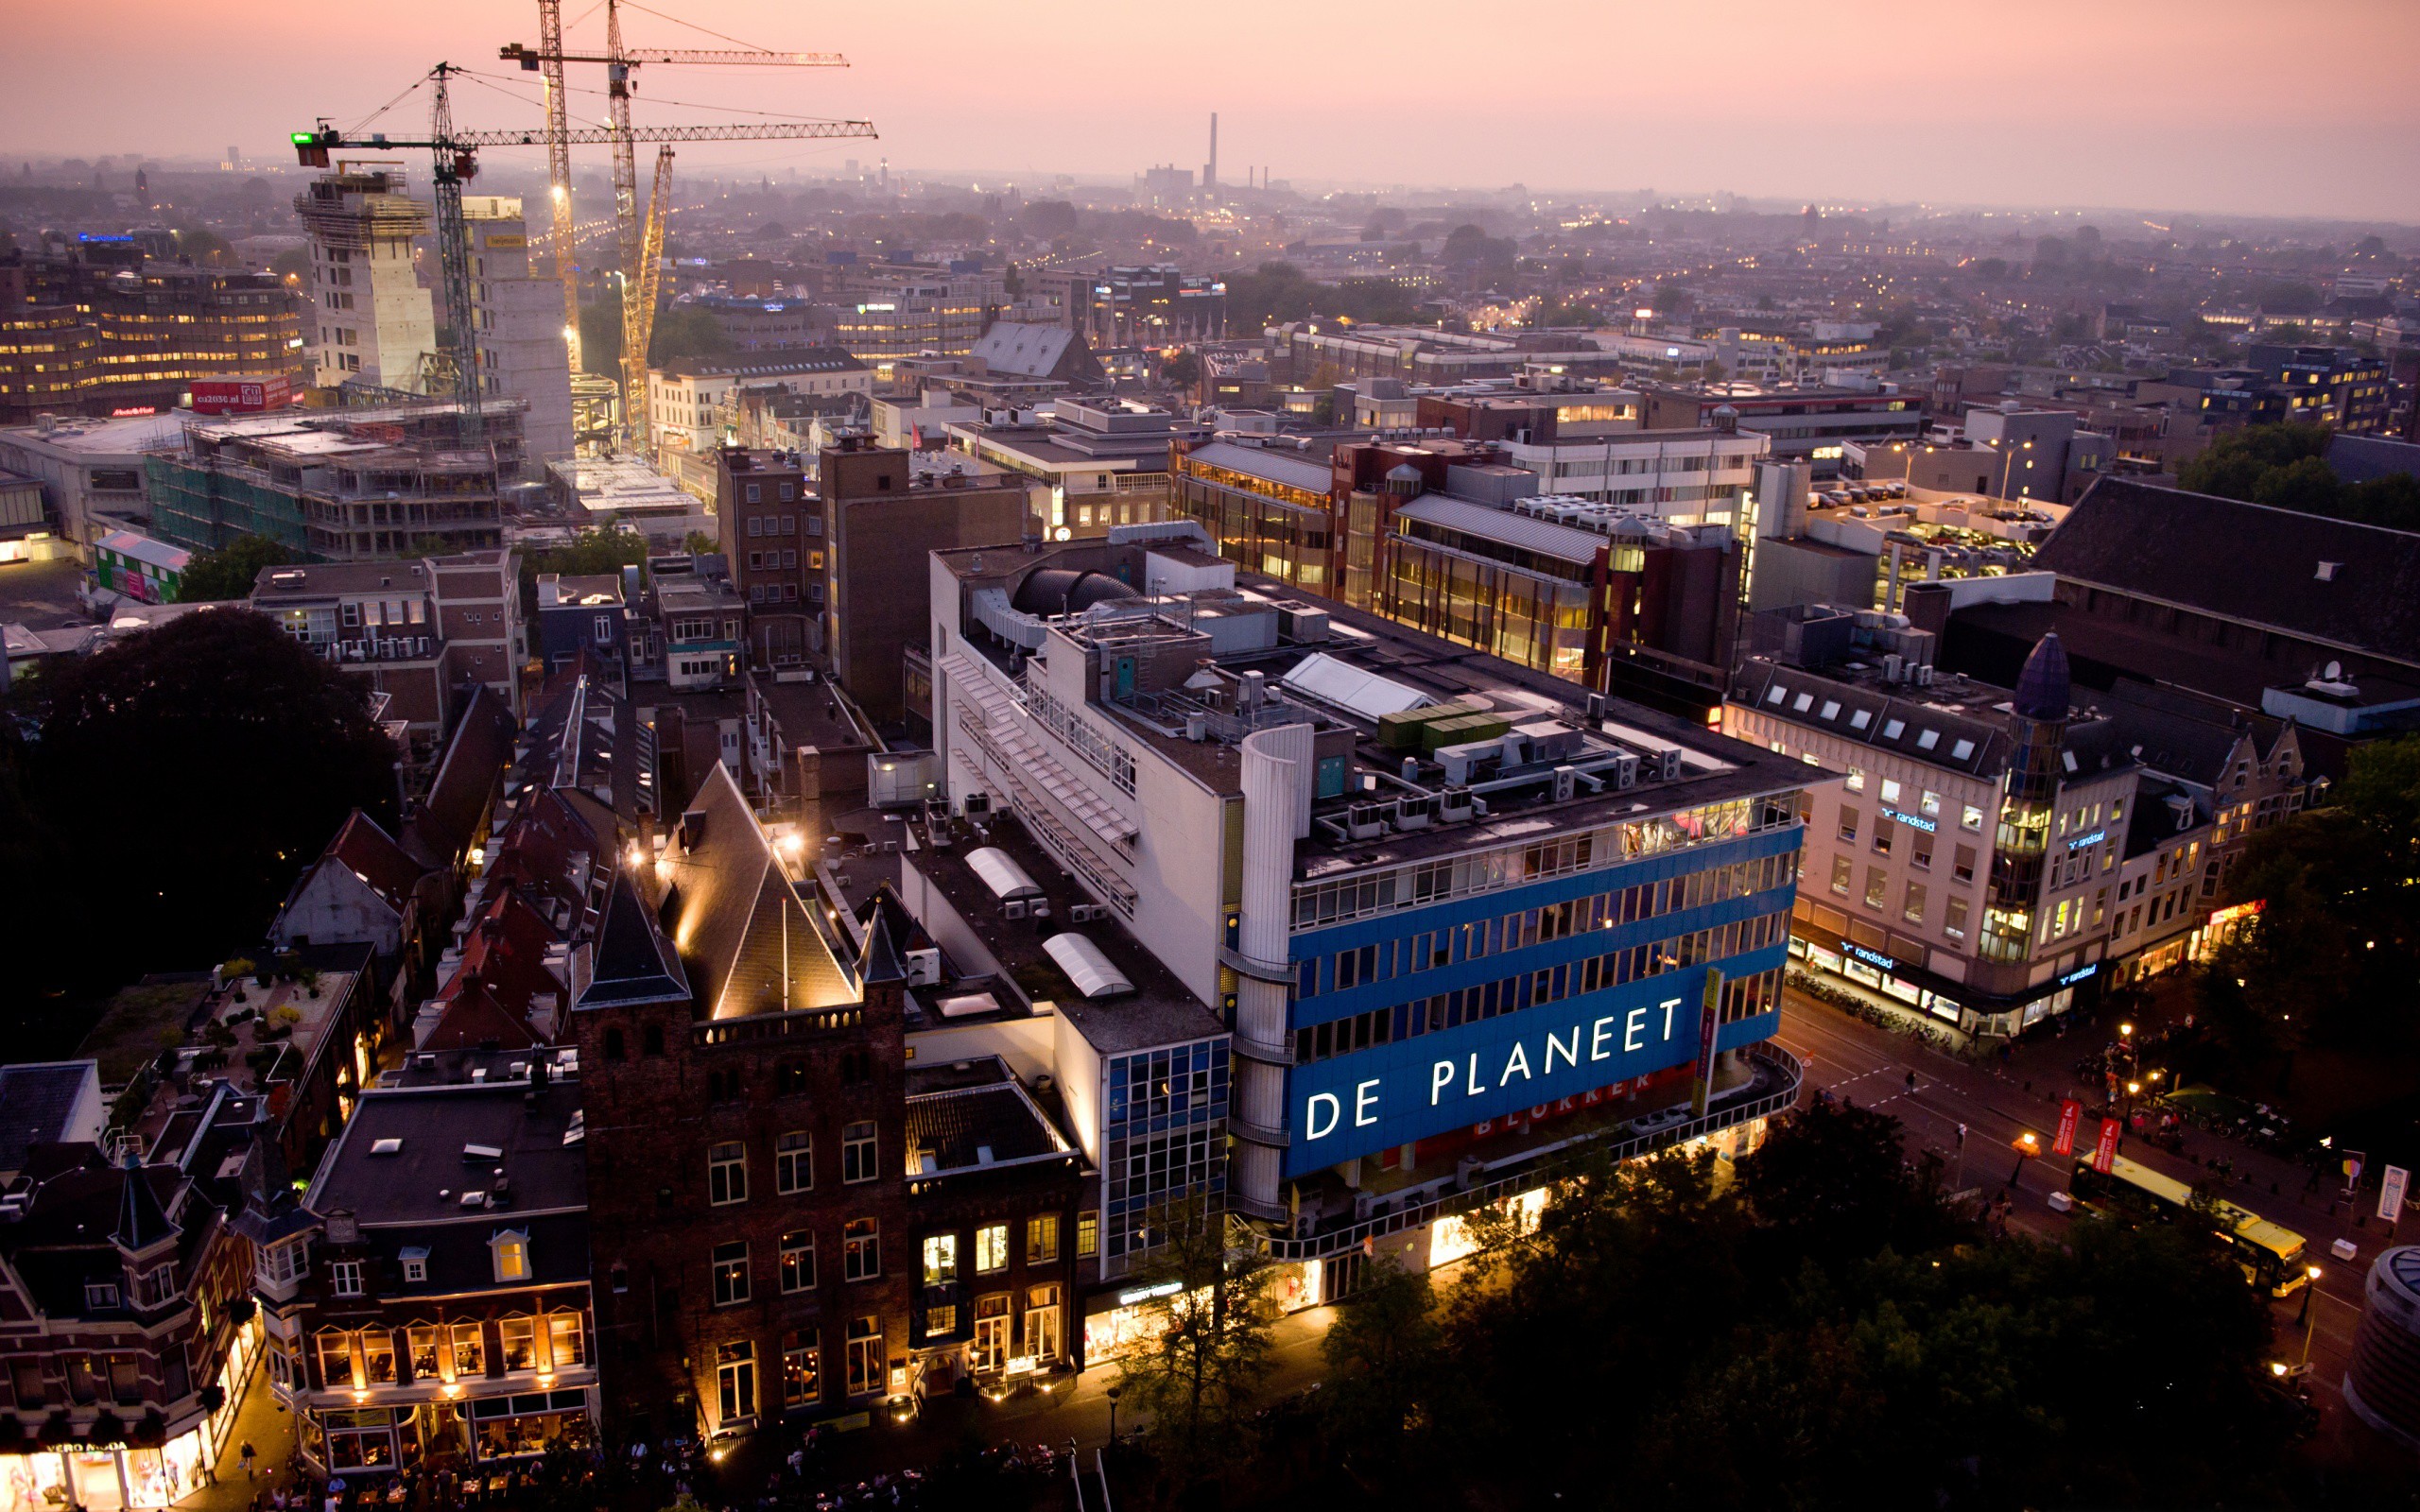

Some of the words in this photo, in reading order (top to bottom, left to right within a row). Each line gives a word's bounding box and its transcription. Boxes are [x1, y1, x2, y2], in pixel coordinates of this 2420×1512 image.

[1896, 812, 1935, 832] randstad
[2078, 830, 2105, 848] randstad
[1855, 947, 1893, 969] randstad
[2069, 962, 2097, 982] randstad
[1306, 1079, 1380, 1141] DE
[1431, 998, 1682, 1106] PLANEET
[1477, 1074, 1649, 1136] BLOKKER
[46, 1443, 83, 1452] VERO
